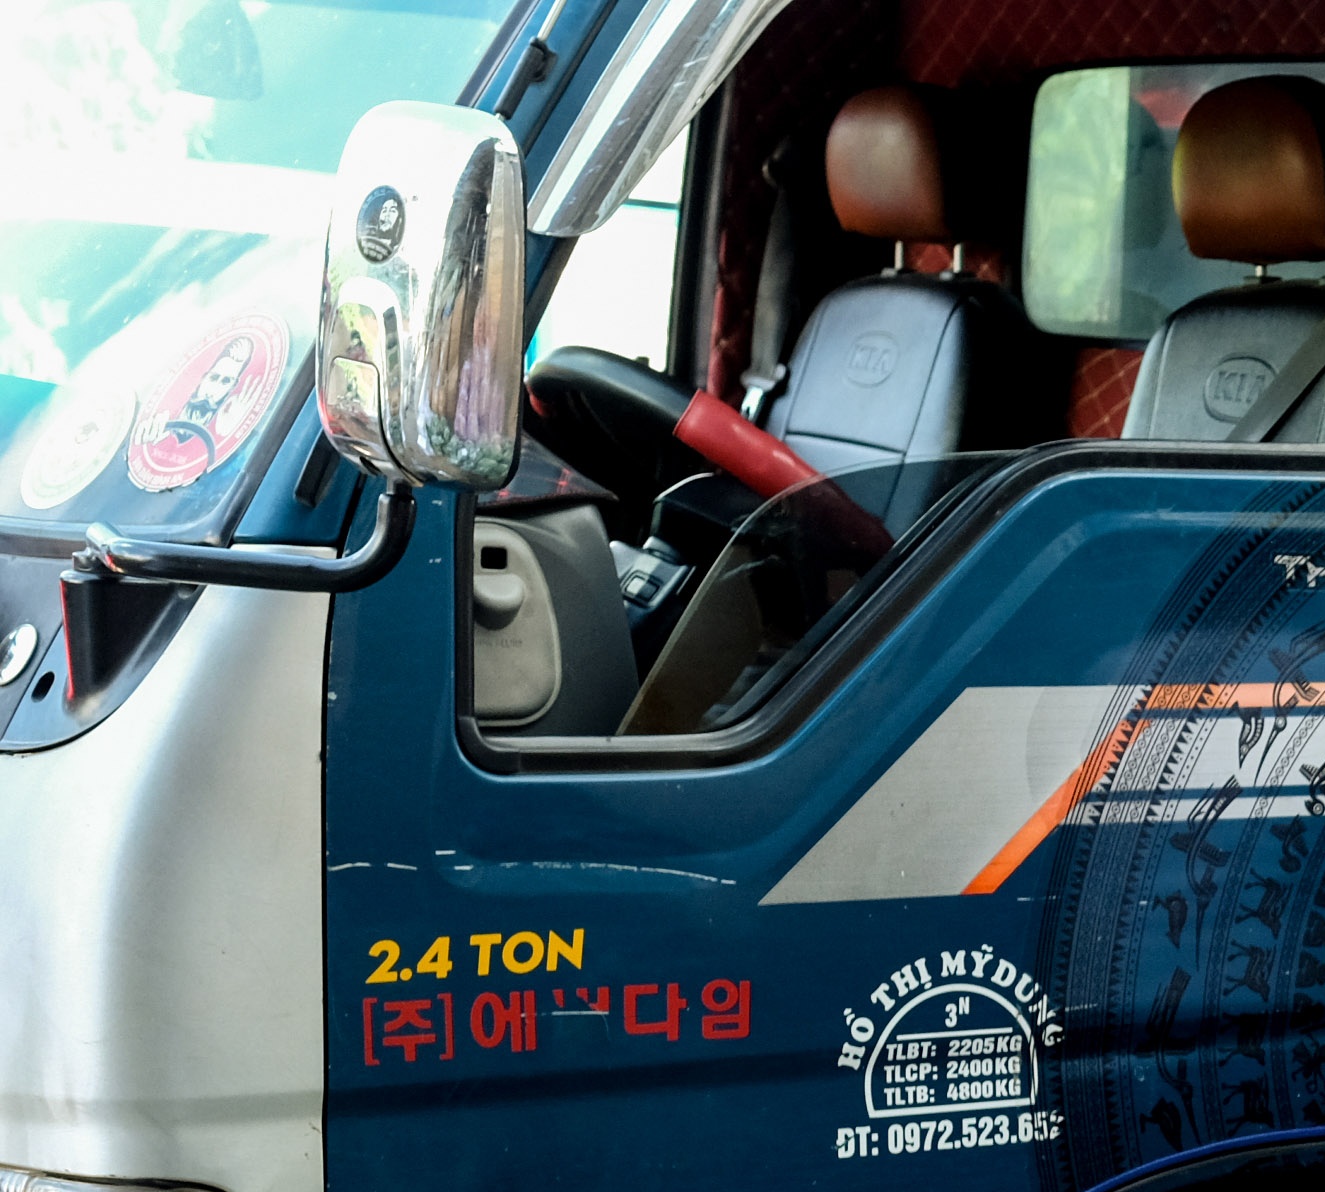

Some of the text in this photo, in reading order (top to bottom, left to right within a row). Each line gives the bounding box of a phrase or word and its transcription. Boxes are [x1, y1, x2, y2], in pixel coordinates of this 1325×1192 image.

[365, 928, 585, 984] 2.4 TON
[870, 957, 932, 1011] THỊ
[886, 1041, 937, 1061] TLBT:
[883, 1063, 938, 1084] TLCP:
[884, 1086, 935, 1106] TLTB:
